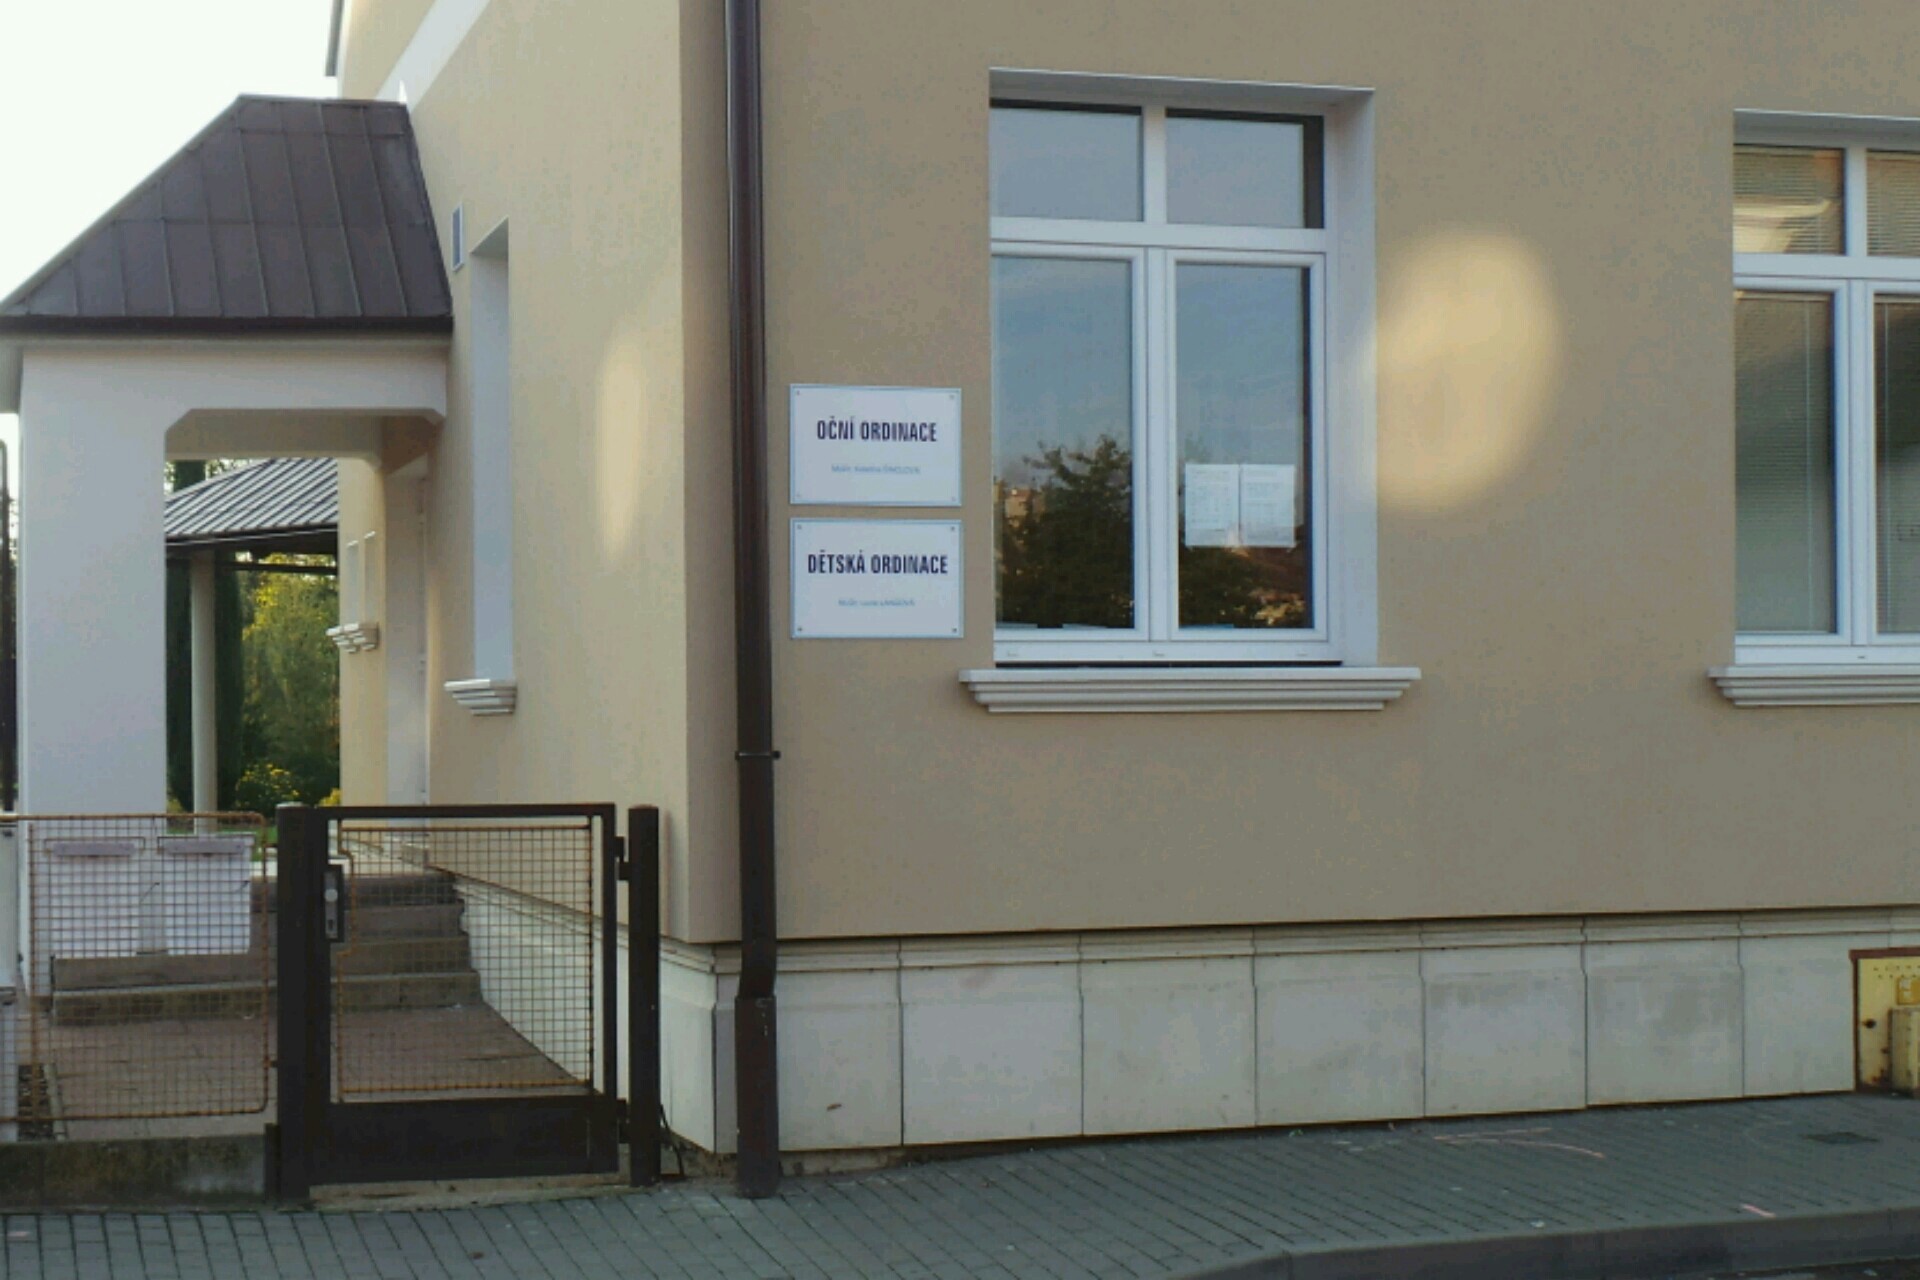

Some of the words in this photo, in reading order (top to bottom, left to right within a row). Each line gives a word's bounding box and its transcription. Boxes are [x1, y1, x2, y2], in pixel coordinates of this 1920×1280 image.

[817, 415, 854, 440] OČNÍ
[860, 421, 937, 442] ORDINACE
[808, 549, 866, 574] DĚTSKÁ
[870, 554, 948, 574] ORDINACE
